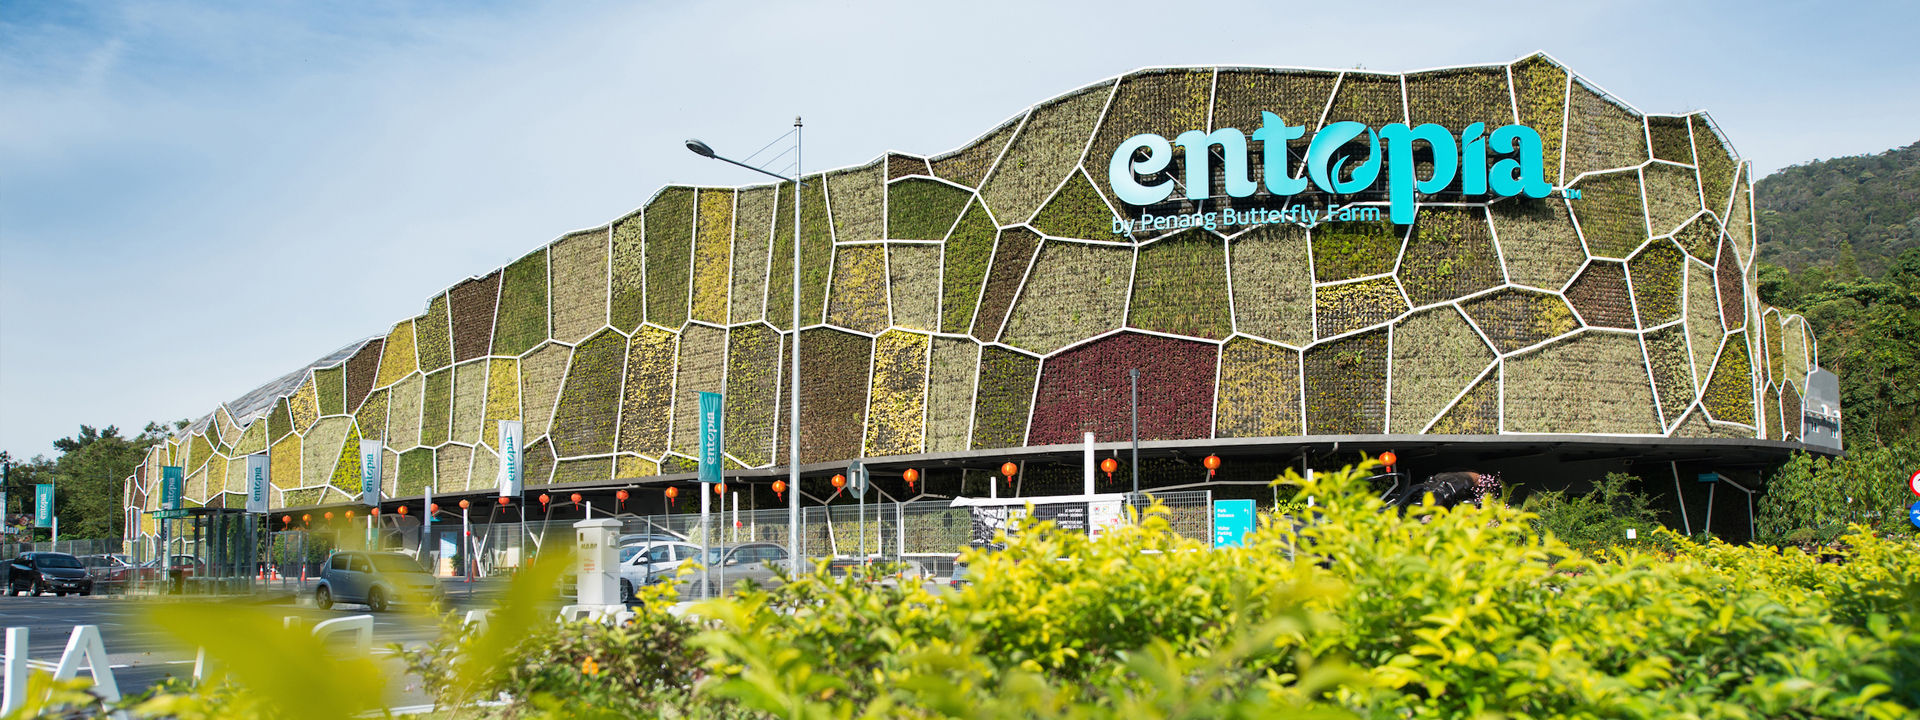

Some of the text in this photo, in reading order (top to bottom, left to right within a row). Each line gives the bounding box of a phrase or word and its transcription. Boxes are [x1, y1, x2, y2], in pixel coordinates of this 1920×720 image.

[1109, 111, 1552, 224] entopia
[1112, 203, 1380, 238] by Penang Butterfly Farm
[507, 436, 517, 482] entopia
[707, 411, 717, 465] entopia
[253, 467, 264, 502] entopia
[366, 453, 376, 493] entopia
